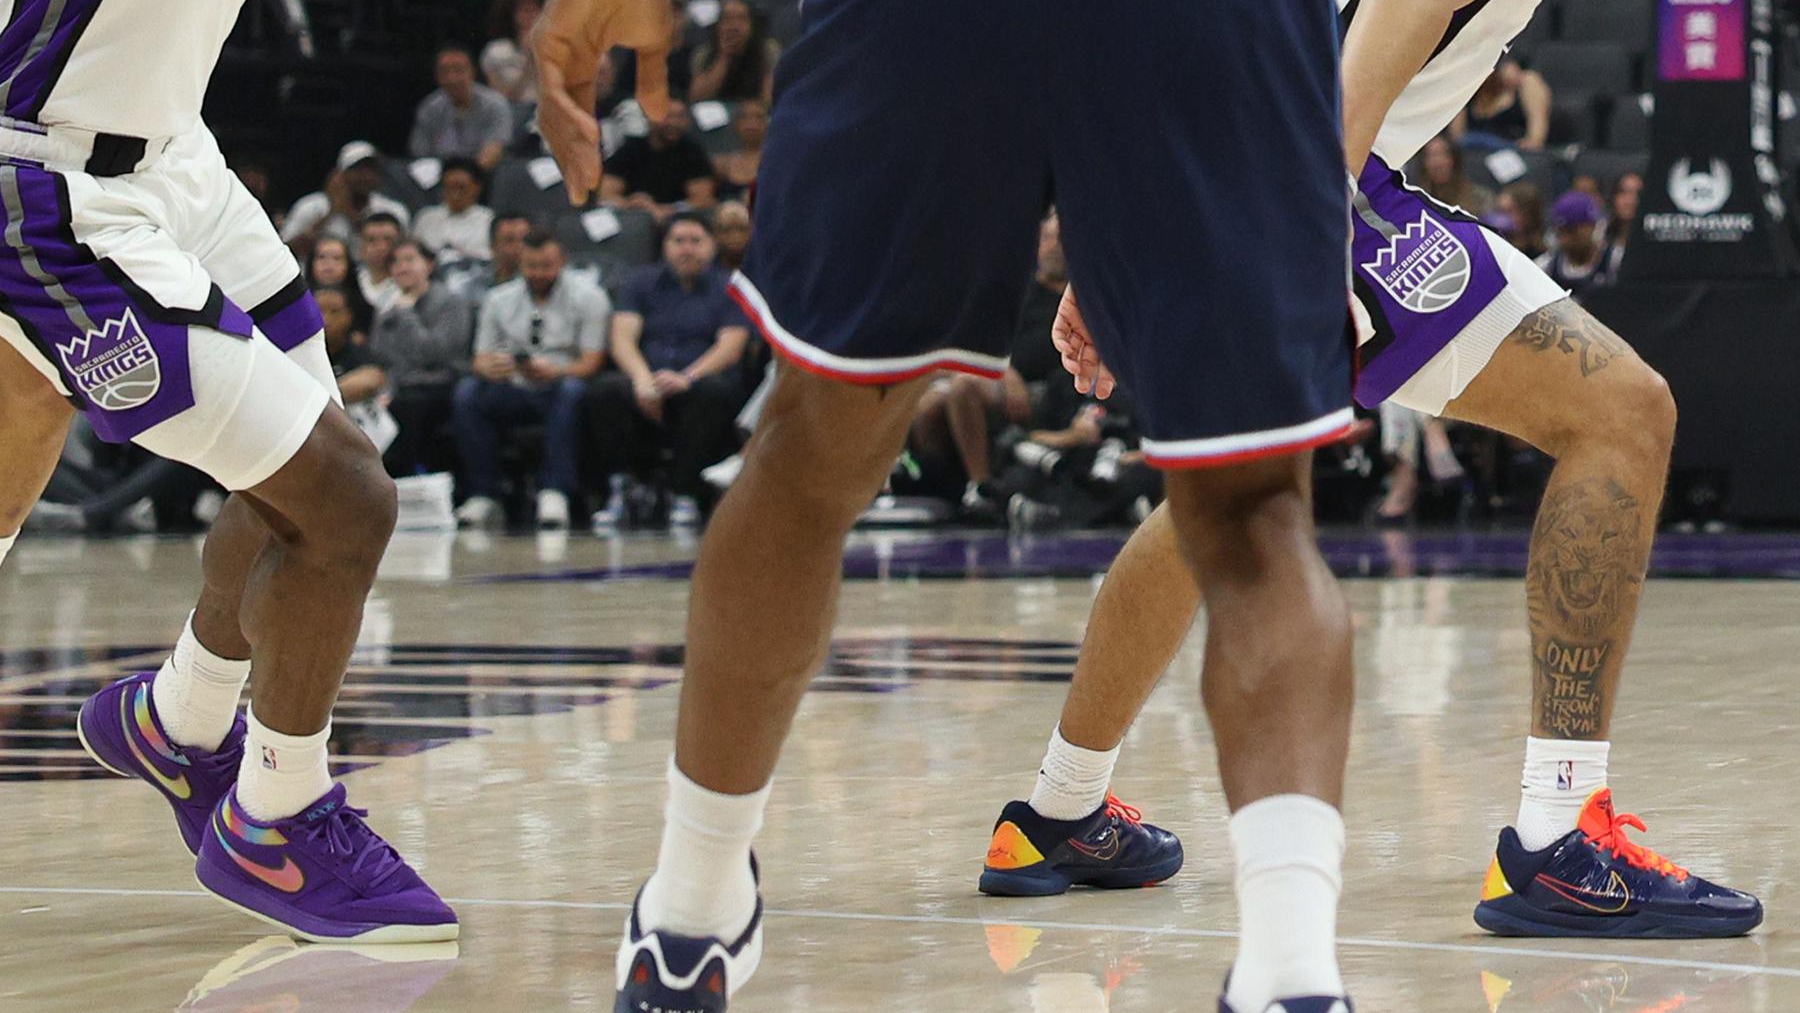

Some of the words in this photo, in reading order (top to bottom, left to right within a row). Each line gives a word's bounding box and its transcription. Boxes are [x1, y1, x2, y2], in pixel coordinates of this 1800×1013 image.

[1385, 229, 1444, 284] SACRAMENTO
[1391, 236, 1460, 300] KINGS
[74, 335, 140, 373] SACRAMENTO
[80, 343, 154, 389] KINGS
[1547, 641, 1608, 676] ONLY
[1549, 672, 1591, 698] THE
